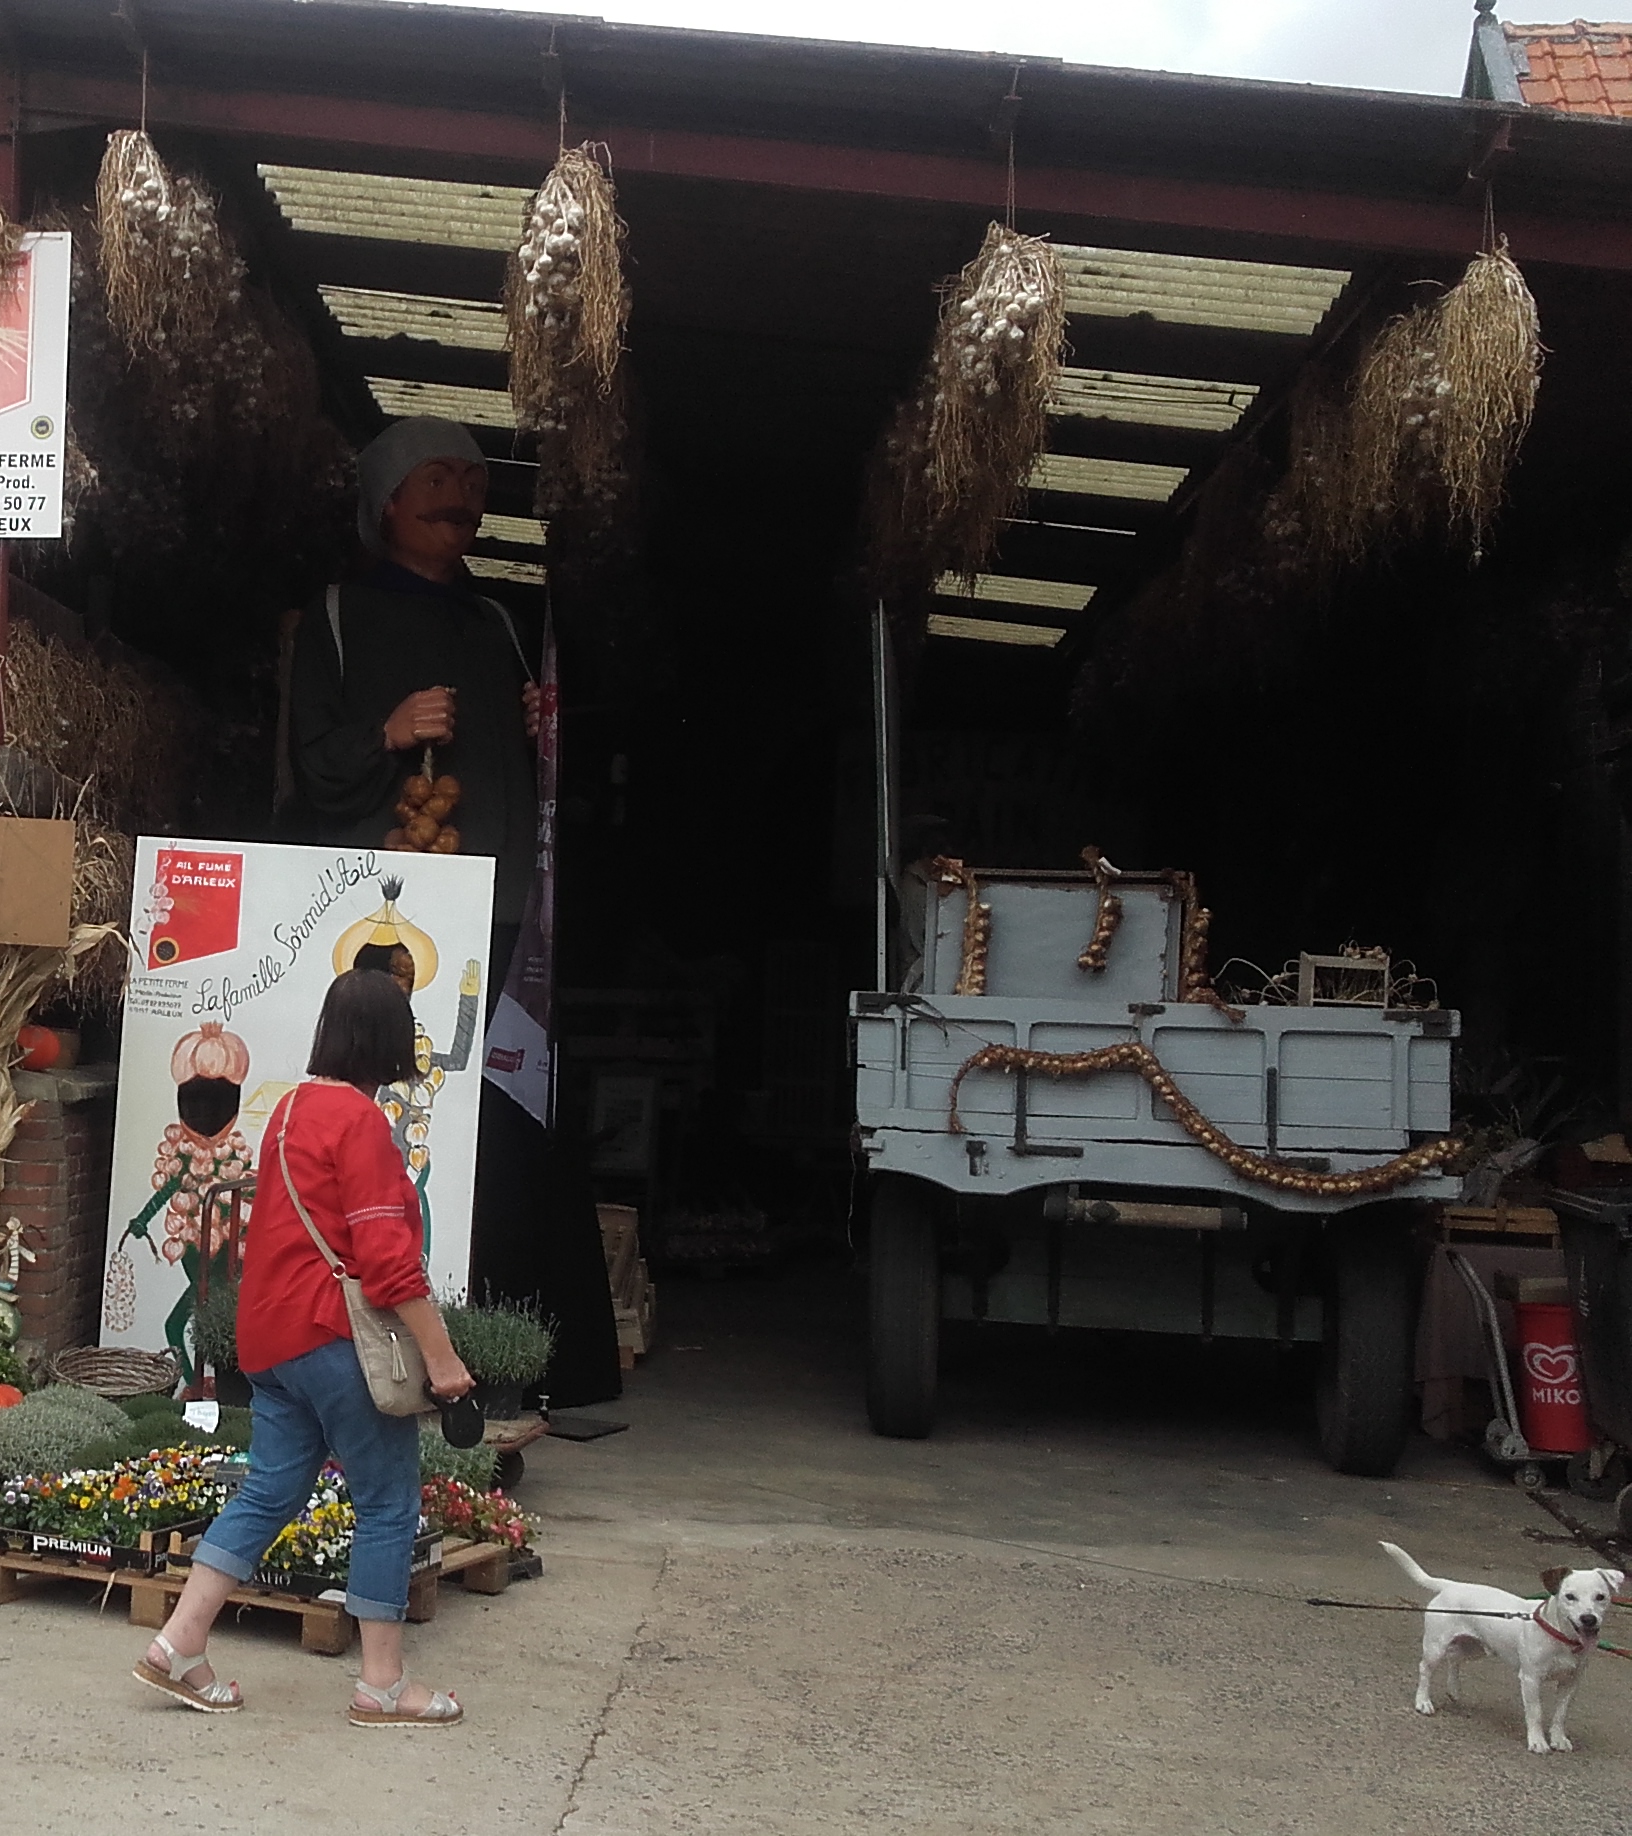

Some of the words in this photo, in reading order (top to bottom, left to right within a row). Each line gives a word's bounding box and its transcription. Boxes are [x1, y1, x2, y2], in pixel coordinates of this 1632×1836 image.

[3, 497, 22, 511] 50
[28, 497, 46, 511] 77
[176, 861, 194, 871] AIL
[198, 860, 232, 872] FUMÉ
[171, 874, 236, 888] D'ARLEUX
[1531, 1387, 1582, 1405] MIKO
[32, 1534, 112, 1558] PREMIUM
